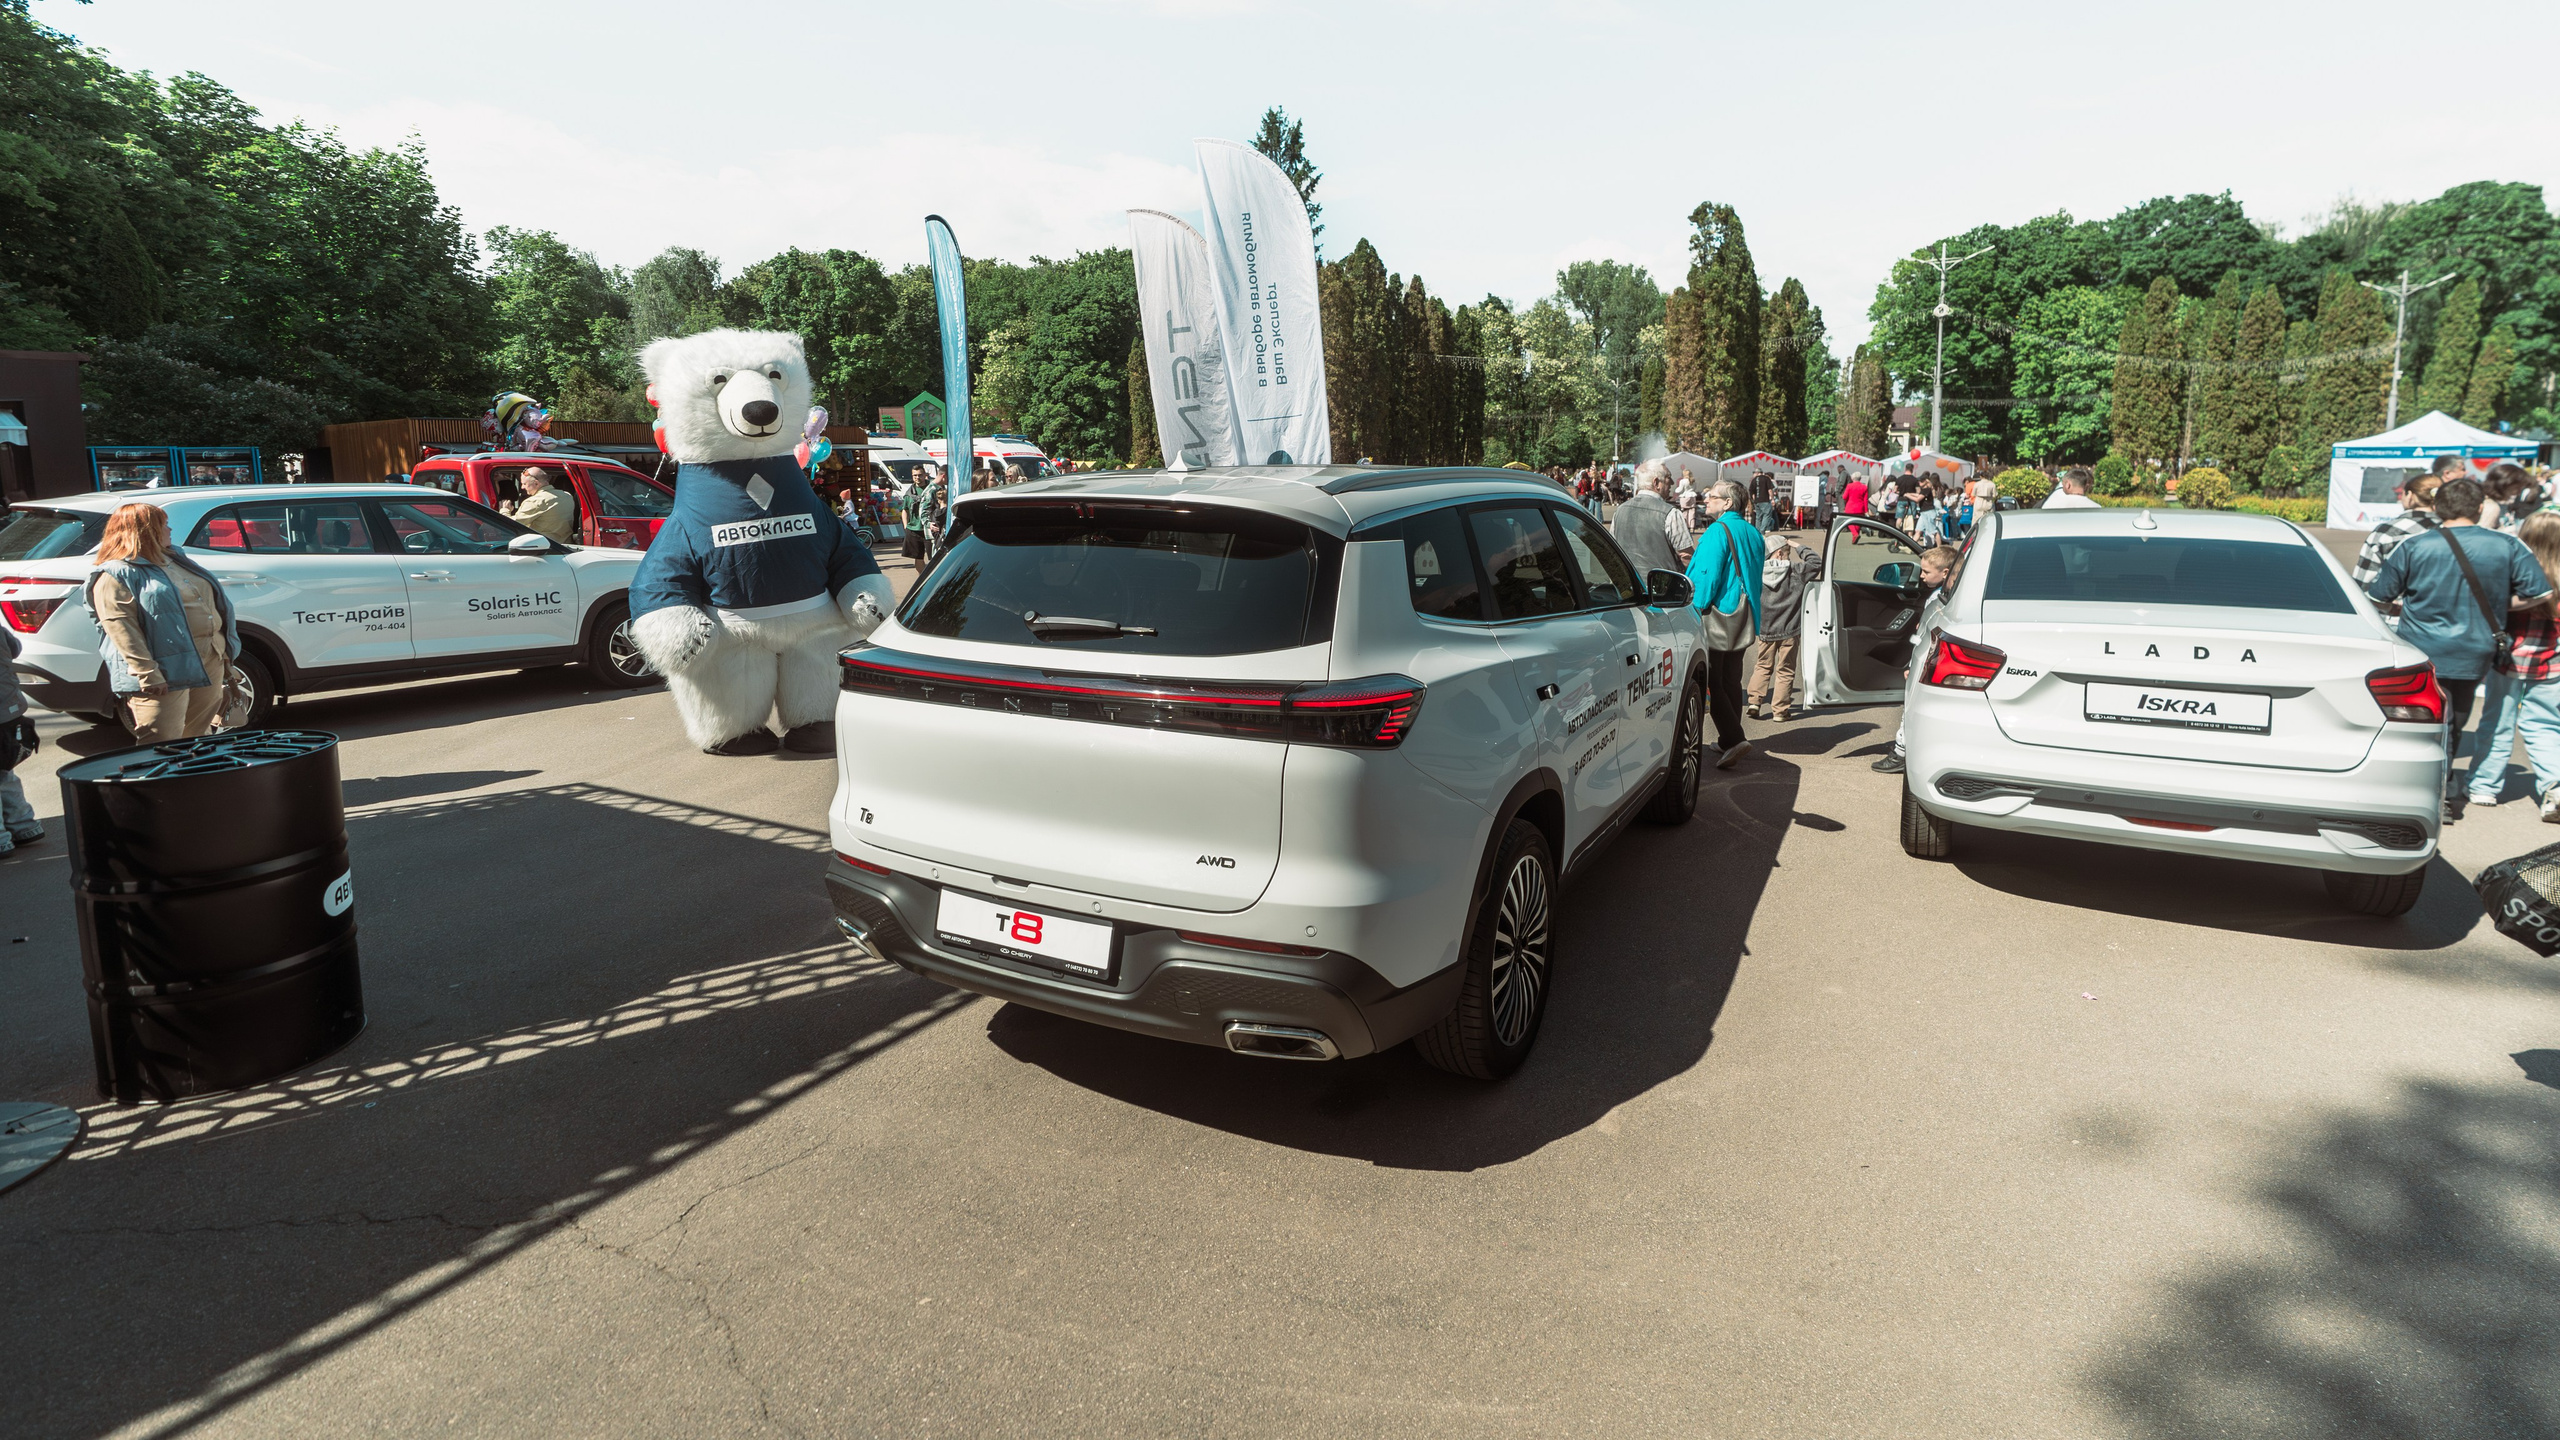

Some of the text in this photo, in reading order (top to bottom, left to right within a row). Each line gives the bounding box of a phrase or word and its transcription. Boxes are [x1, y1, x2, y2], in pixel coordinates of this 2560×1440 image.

[717, 518, 813, 542] АВТОКЛАСС
[467, 591, 562, 612] Solaris HC
[292, 605, 405, 625] Тест-драйв
[486, 608, 563, 621] Solaris Автокласс
[364, 622, 406, 632] 704-404
[2104, 641, 2257, 663] LADA
[1626, 648, 1673, 707] TENET T8
[2005, 666, 2038, 678] ISKRA
[920, 686, 1122, 721] TENET
[2136, 693, 2218, 716] ISKRA
[859, 807, 875, 825] T8
[1195, 854, 1236, 869] AWD
[995, 911, 1044, 945] T8
[1010, 950, 1033, 960] CHERY
